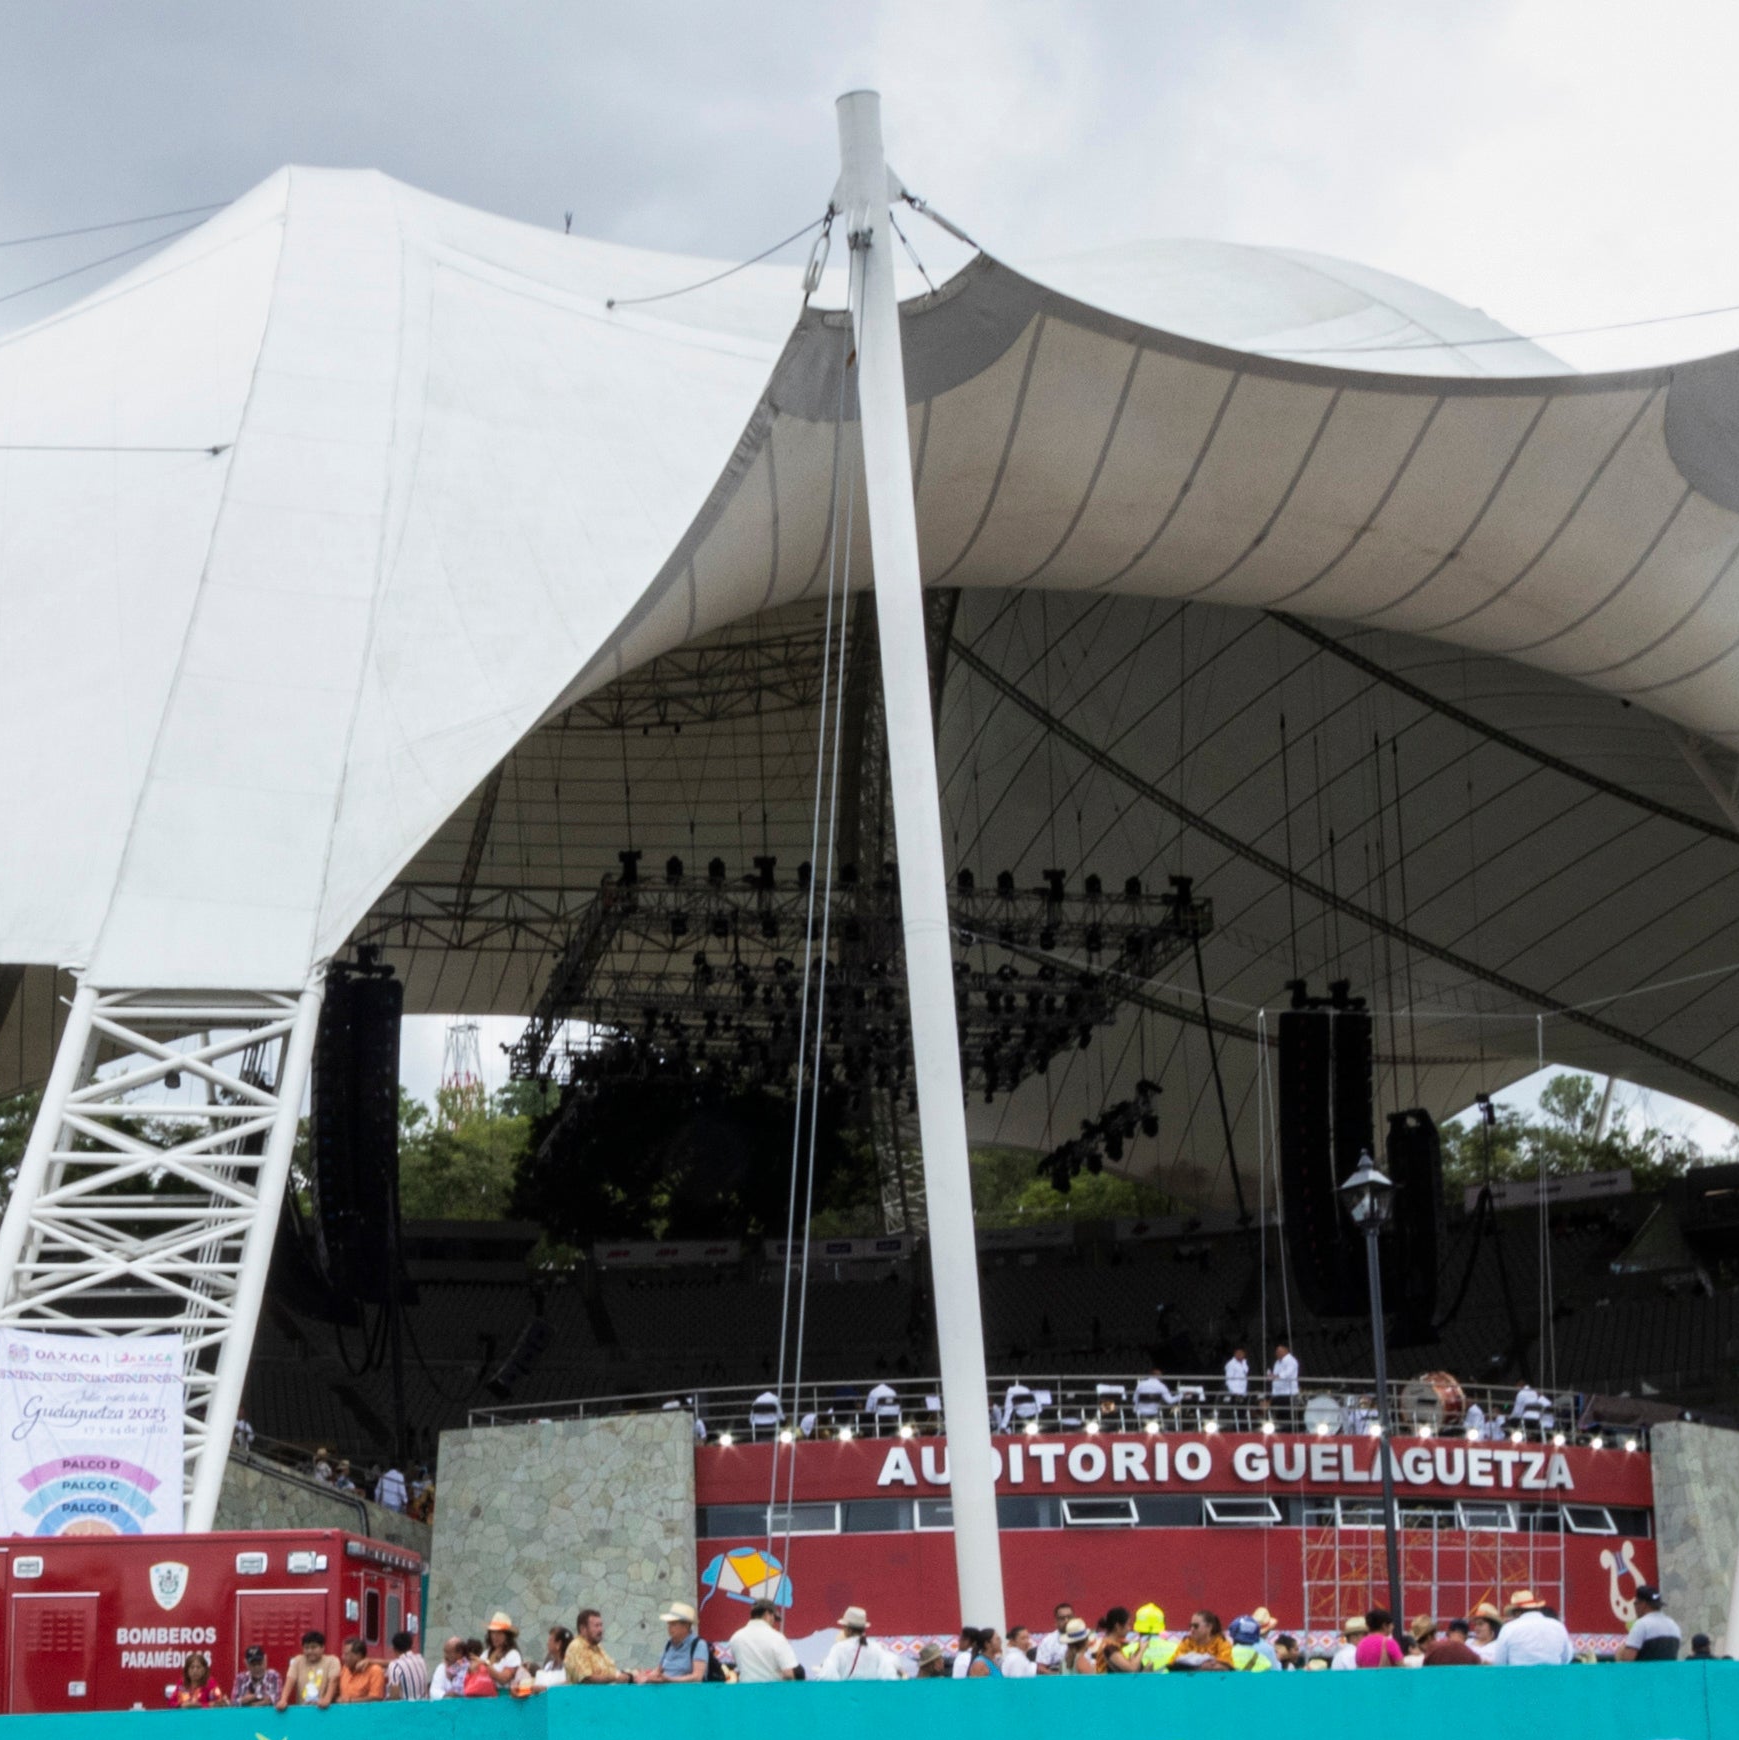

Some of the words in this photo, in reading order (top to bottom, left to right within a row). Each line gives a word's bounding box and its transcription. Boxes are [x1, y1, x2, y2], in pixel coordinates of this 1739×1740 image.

[12, 1395, 124, 1441] Guelaguetza
[62, 1460, 107, 1470] PALCO
[110, 1460, 120, 1470] D
[876, 1441, 1213, 1487] AUITORIO
[1232, 1442, 1575, 1491] GUELAGUETZA
[62, 1481, 106, 1491] PALCO
[110, 1481, 120, 1491] C
[62, 1503, 106, 1513] PALCO
[110, 1503, 119, 1513] B
[116, 1627, 216, 1645] BOMBEROS
[121, 1647, 212, 1668] PARAMÉDIS
